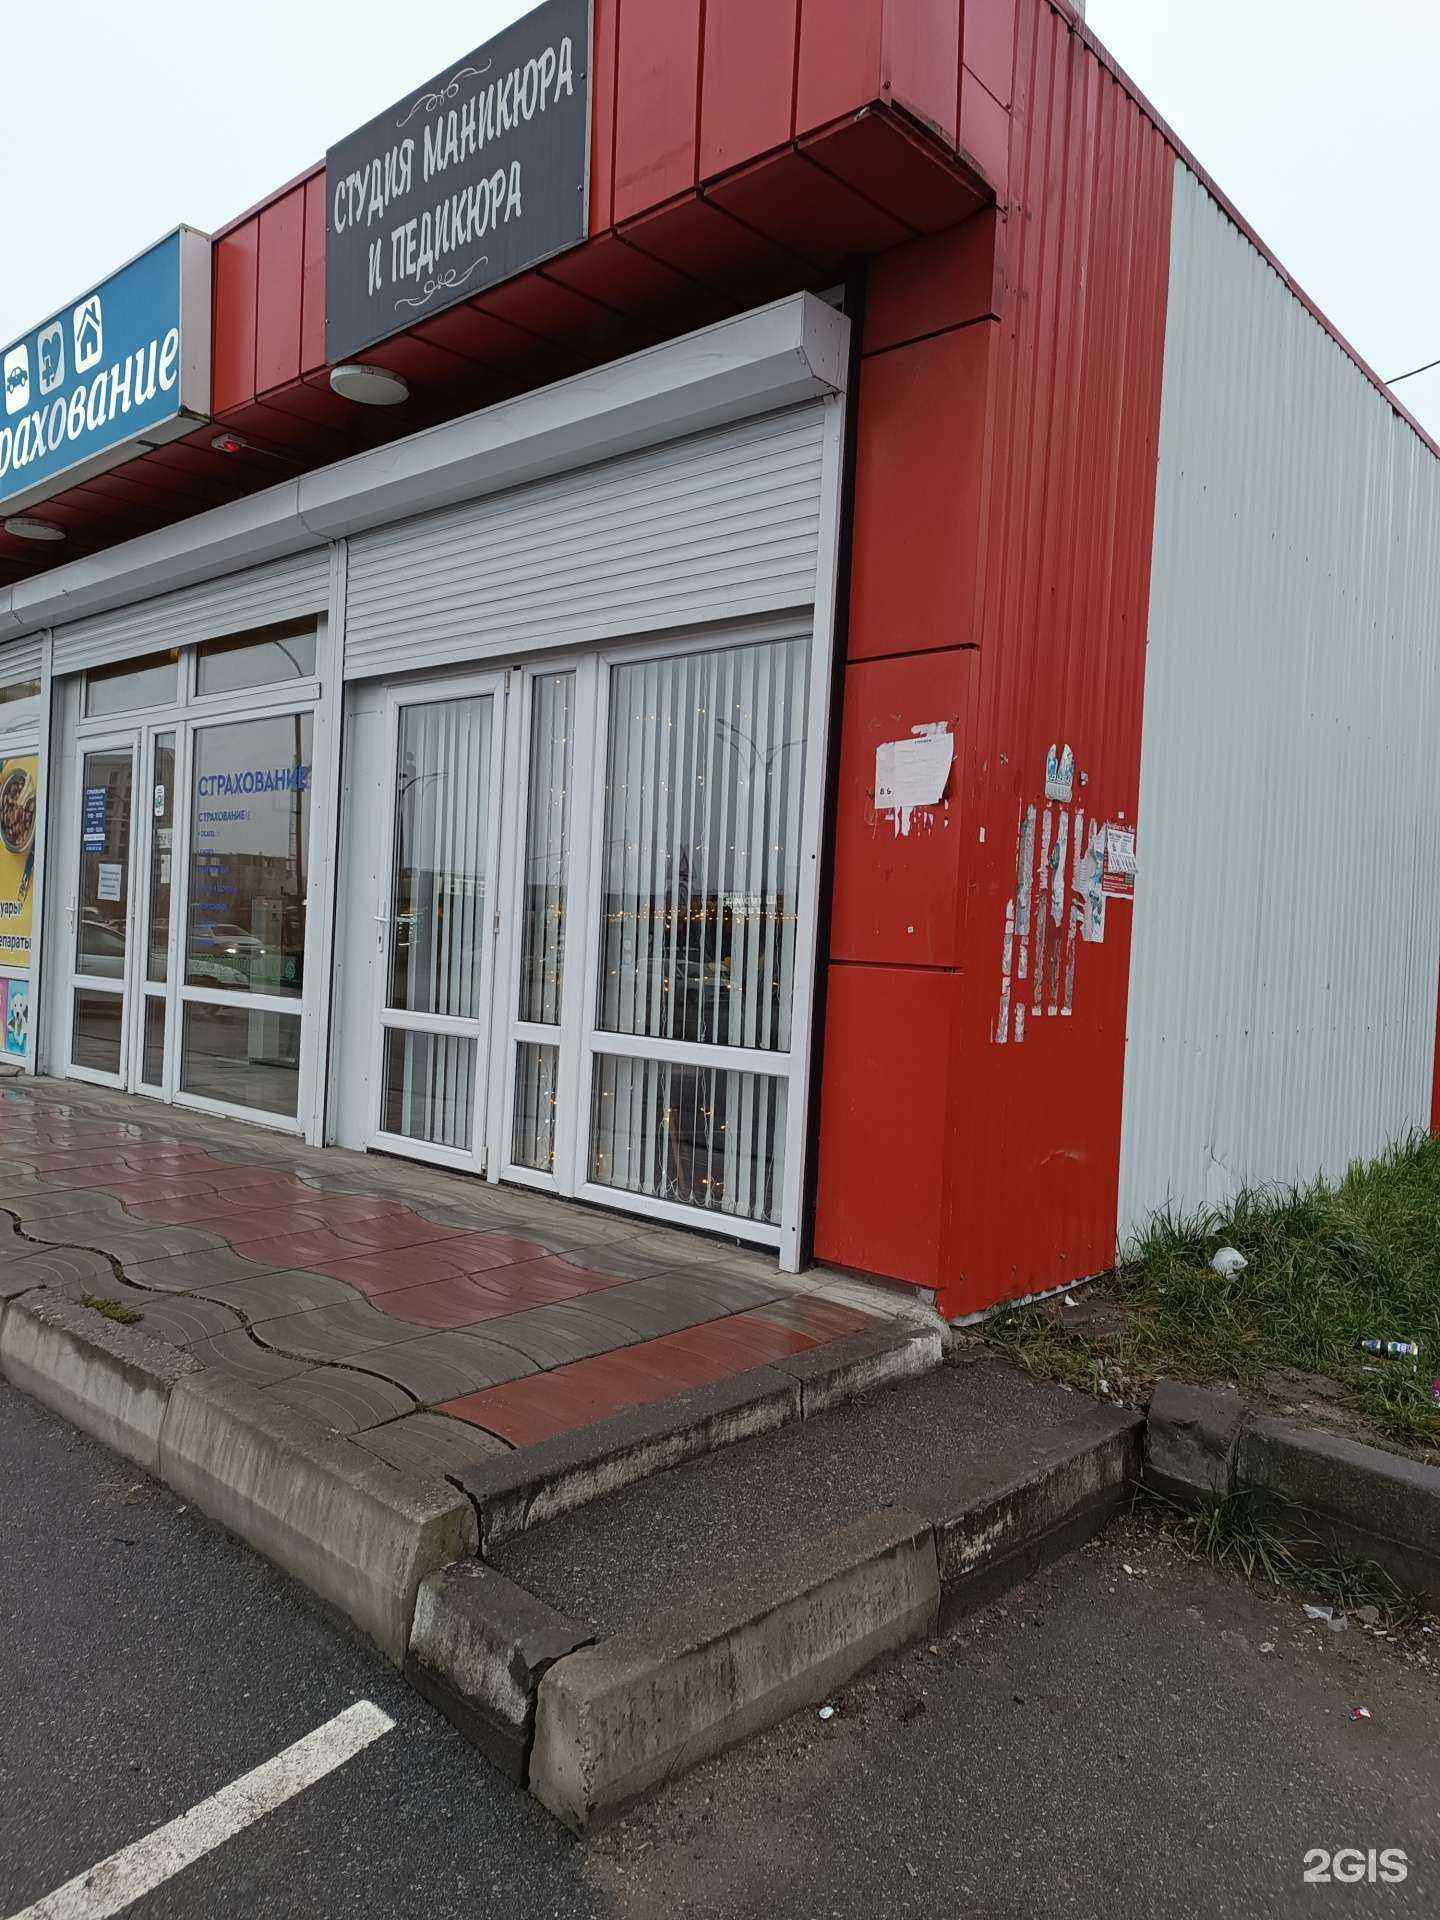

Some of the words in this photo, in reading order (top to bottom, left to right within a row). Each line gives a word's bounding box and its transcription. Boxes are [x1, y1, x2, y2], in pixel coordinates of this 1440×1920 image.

[334, 138, 414, 234] СТУДИЯ
[424, 37, 574, 183] МАНИКЮРА
[368, 238, 382, 297] И
[391, 161, 522, 282] ПЕДИКЮРА
